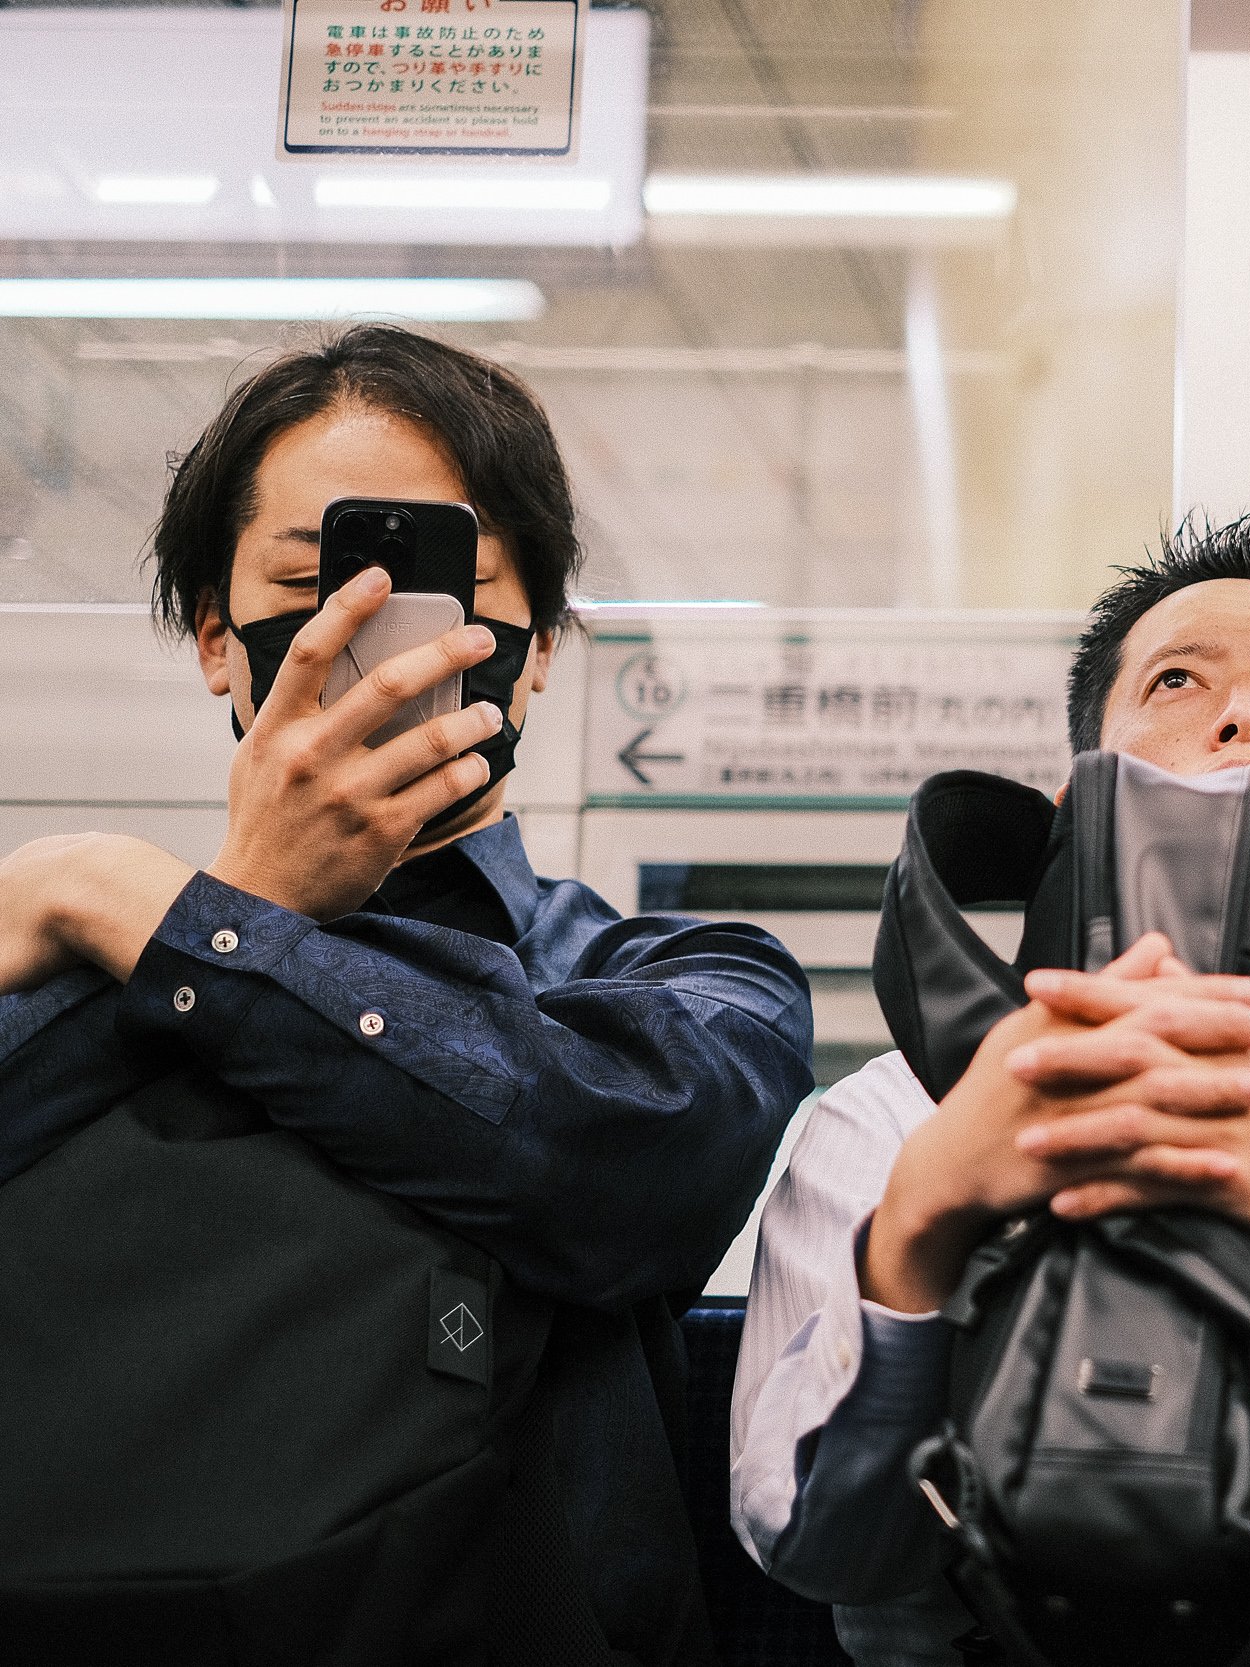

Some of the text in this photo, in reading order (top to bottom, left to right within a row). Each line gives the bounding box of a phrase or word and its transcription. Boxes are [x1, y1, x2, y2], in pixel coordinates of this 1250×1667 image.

[326, 25, 545, 40] 電車は事故防止のため
[324, 43, 541, 58] 急停車することがありま
[398, 104, 416, 112] are
[320, 115, 331, 123] to
[335, 115, 380, 126] prevent
[402, 115, 450, 125] accident
[337, 128, 349, 136] to
